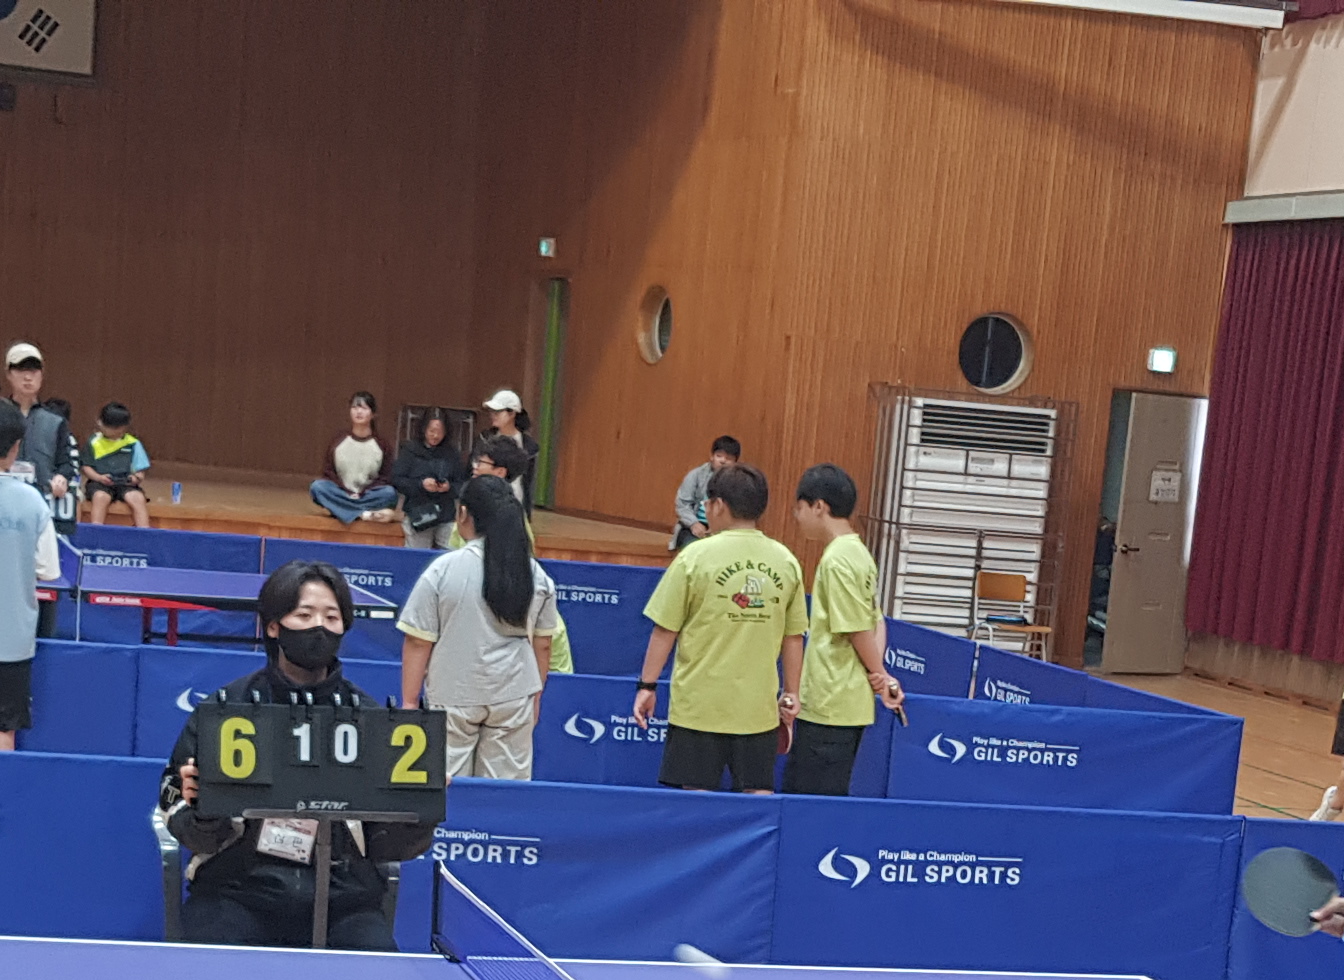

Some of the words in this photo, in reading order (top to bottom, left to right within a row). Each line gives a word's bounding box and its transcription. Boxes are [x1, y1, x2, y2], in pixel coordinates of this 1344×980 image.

[746, 560, 755, 570] &
[570, 591, 619, 605] SPORTS
[613, 726, 643, 741] GIL
[219, 716, 257, 779] 6
[292, 723, 311, 762] 1
[334, 723, 358, 764] 0
[390, 723, 428, 784] 2
[973, 746, 1002, 762] GIL
[1006, 749, 1078, 767] SPORTS
[433, 827, 489, 841] Champion
[432, 841, 538, 865] SPORTS
[878, 849, 899, 862] Play
[926, 851, 976, 863] Champion
[880, 863, 918, 882] GIL
[925, 865, 1020, 886] SPORTS
